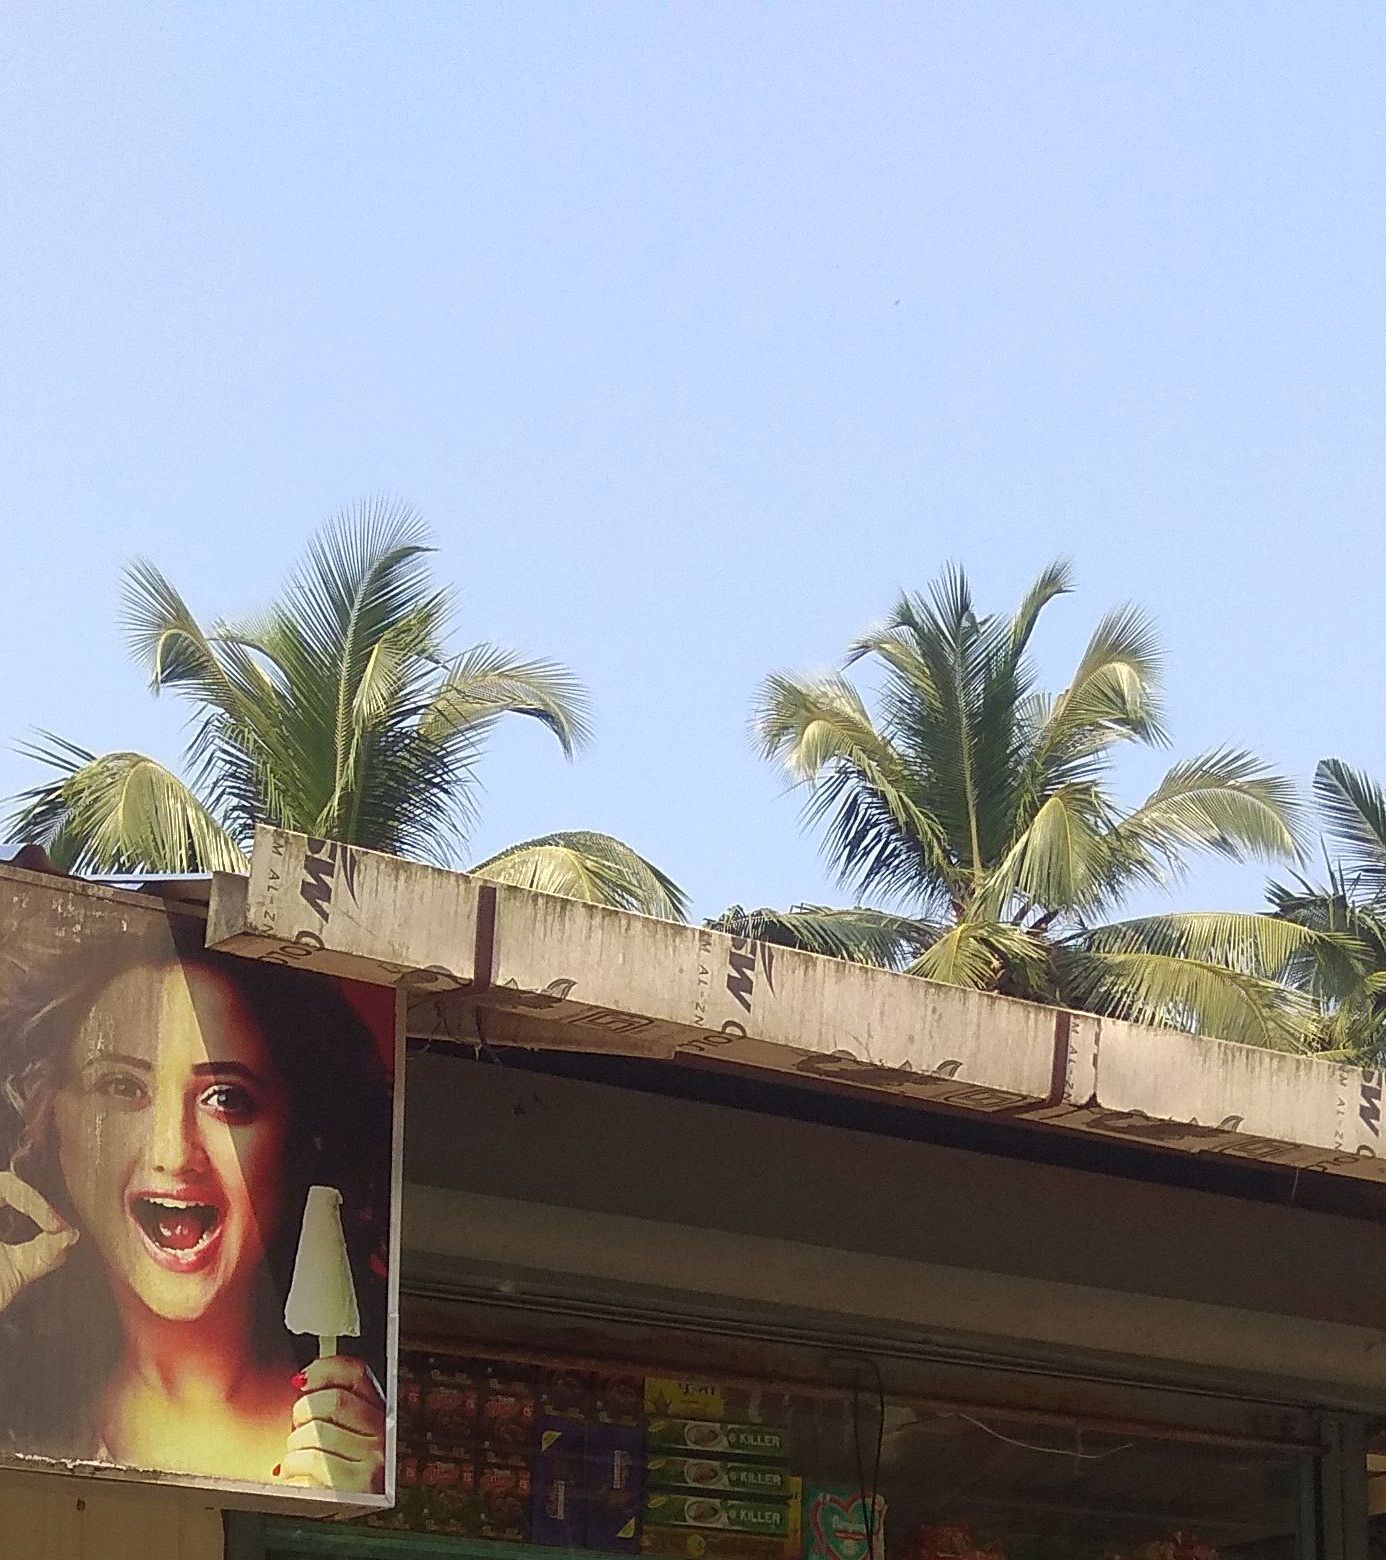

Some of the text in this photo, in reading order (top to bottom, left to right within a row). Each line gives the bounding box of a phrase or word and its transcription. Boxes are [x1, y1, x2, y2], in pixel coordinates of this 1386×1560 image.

[739, 1434, 780, 1447] KILLER
[739, 1471, 781, 1486] KILLER
[739, 1510, 781, 1524] KILLER
